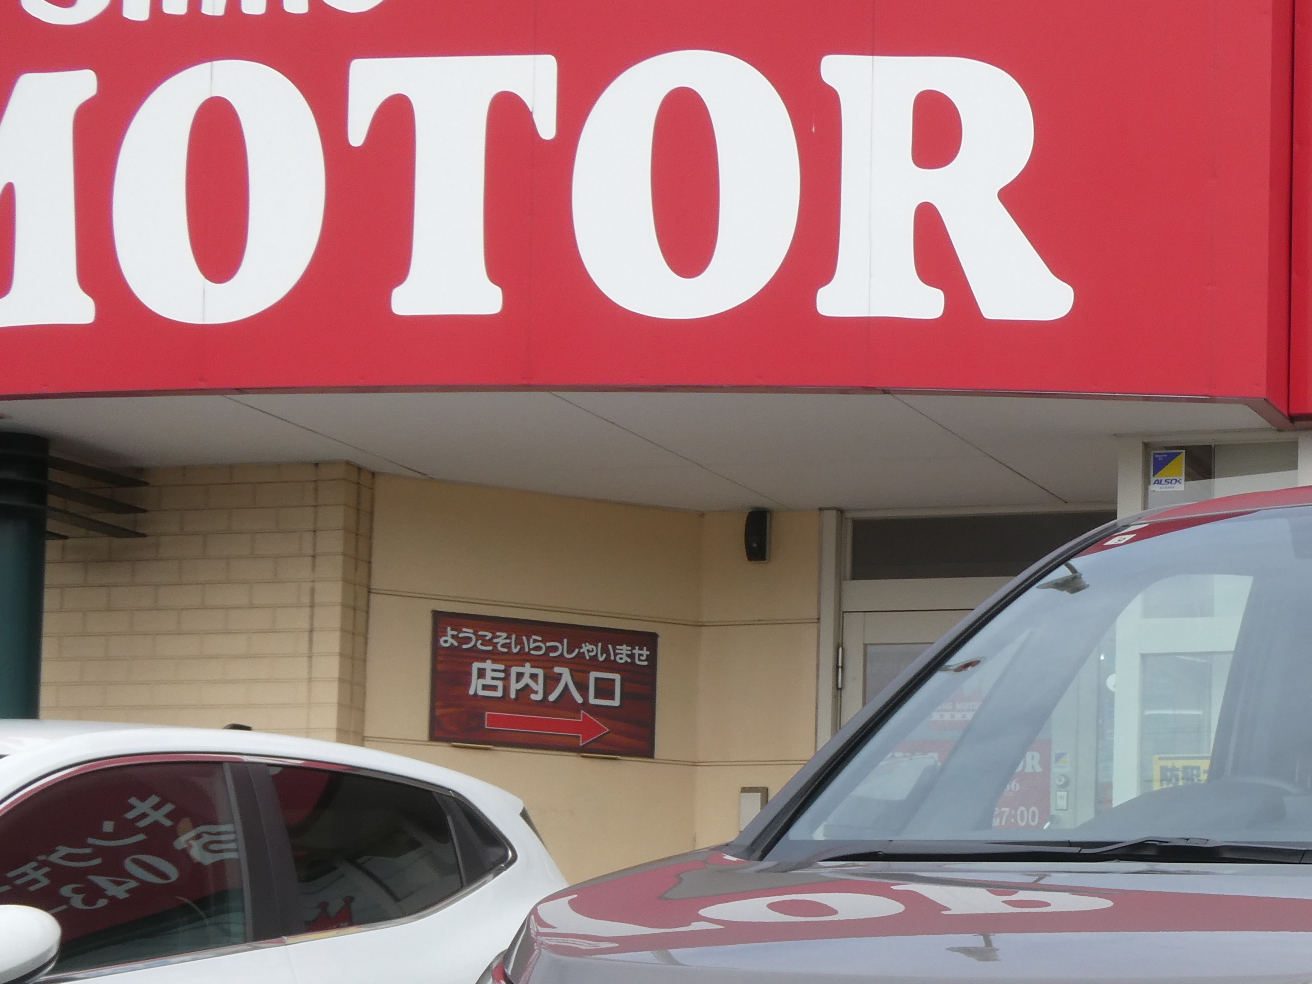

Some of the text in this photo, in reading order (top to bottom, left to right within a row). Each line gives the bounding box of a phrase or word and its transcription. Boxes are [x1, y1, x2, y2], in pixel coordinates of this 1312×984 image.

[439, 626, 650, 665] ようこそいらっしゃいませ
[468, 659, 621, 707] 店内入口
